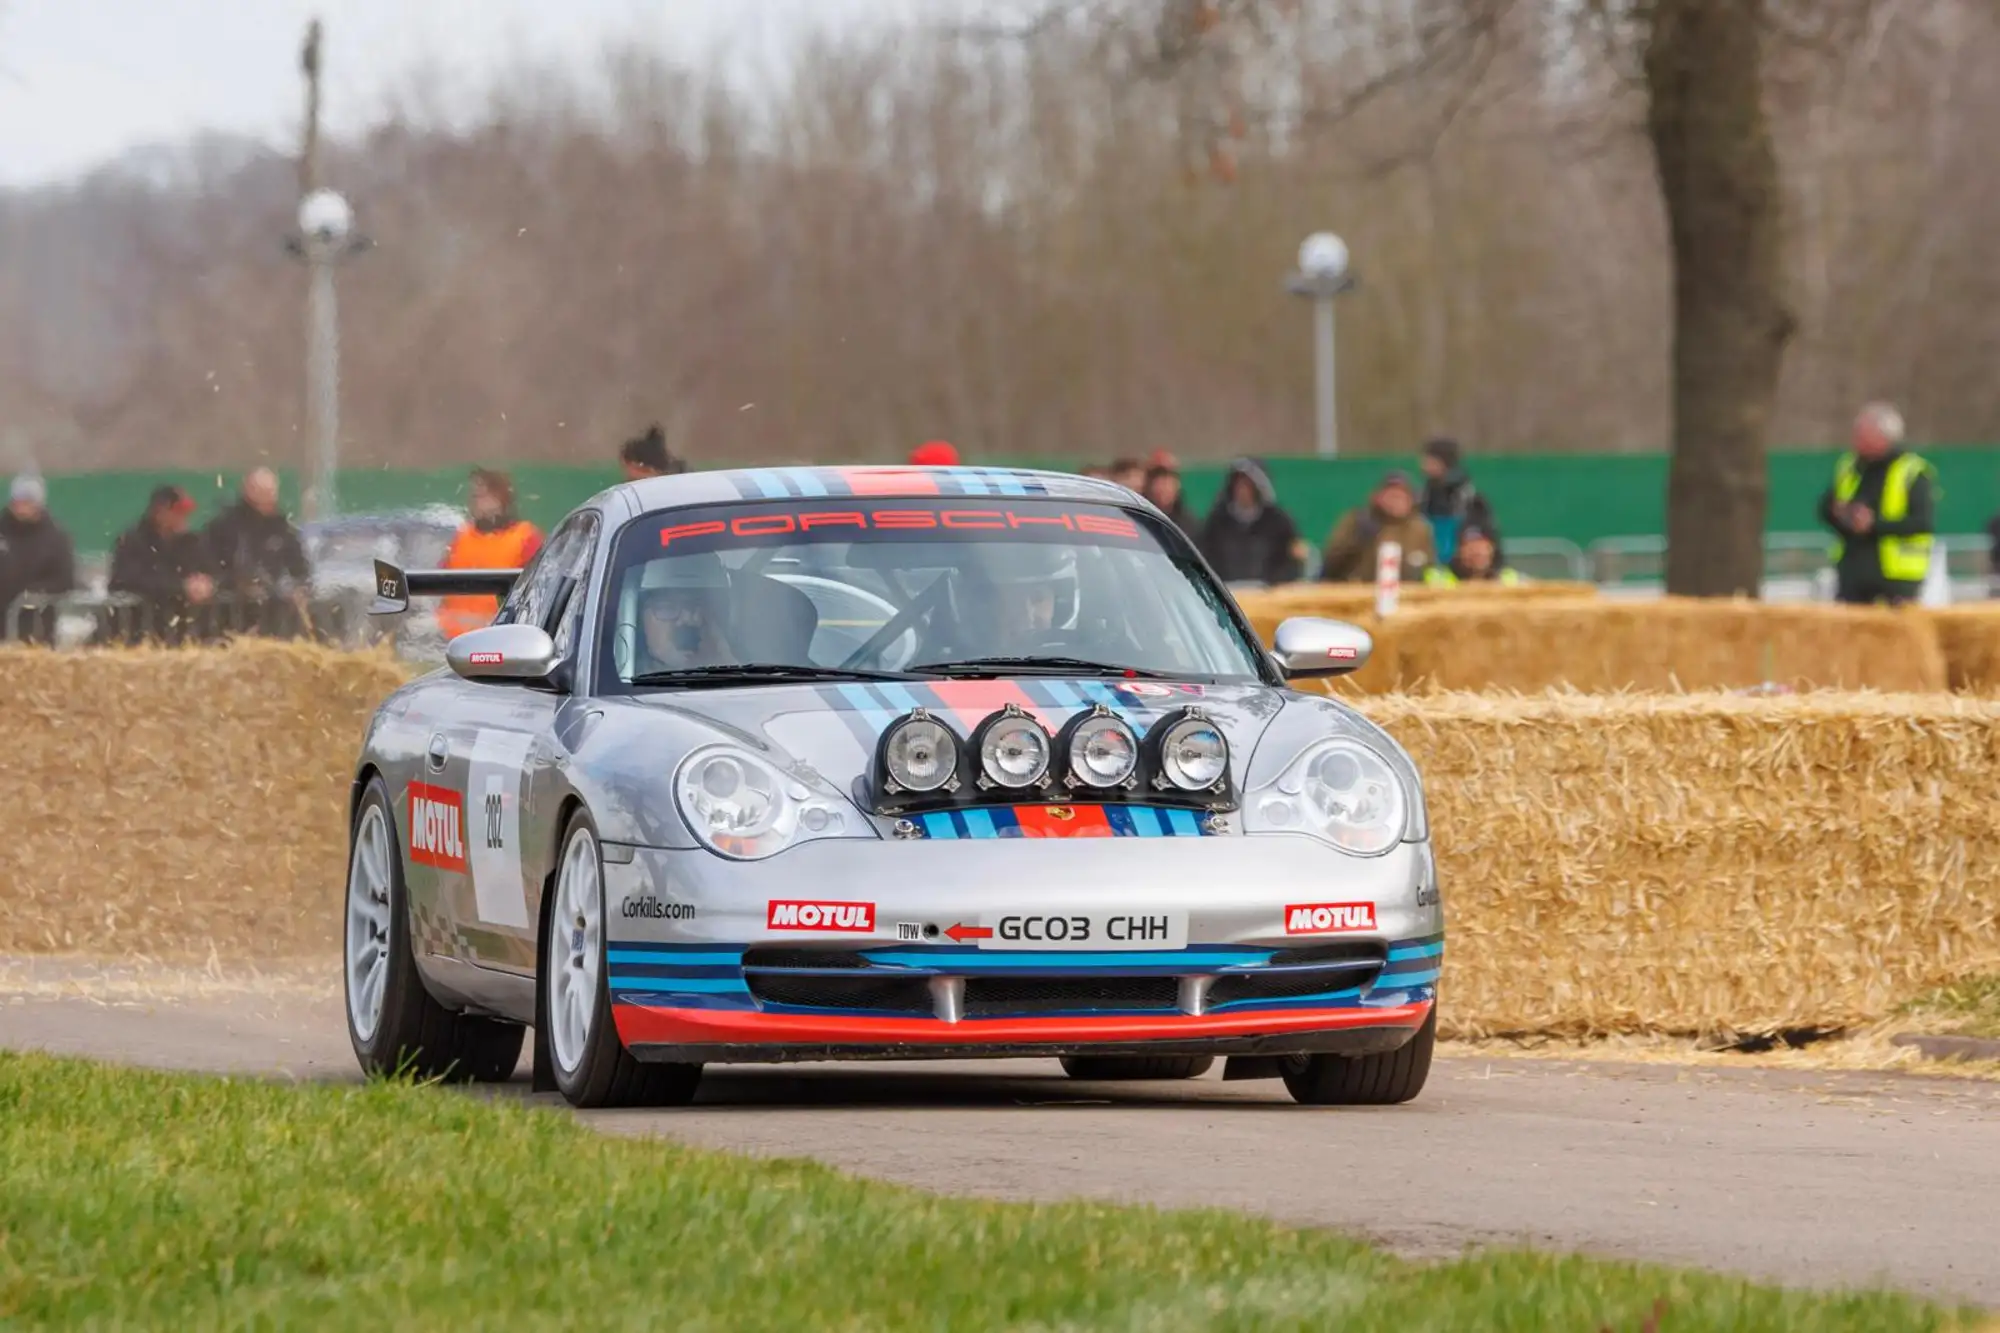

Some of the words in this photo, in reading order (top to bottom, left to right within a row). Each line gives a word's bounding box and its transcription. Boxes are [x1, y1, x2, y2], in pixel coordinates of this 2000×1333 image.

[660, 510, 1139, 547] PORSCHE
[471, 654, 501, 662] MOTUL
[412, 796, 463, 859] MOTUL
[486, 794, 503, 849] 202
[621, 896, 695, 919] Corkills.com
[771, 904, 870, 927] MOTUL
[1289, 906, 1374, 930] MOTUL
[898, 923, 920, 939] TOW
[1106, 916, 1168, 940] CHH
